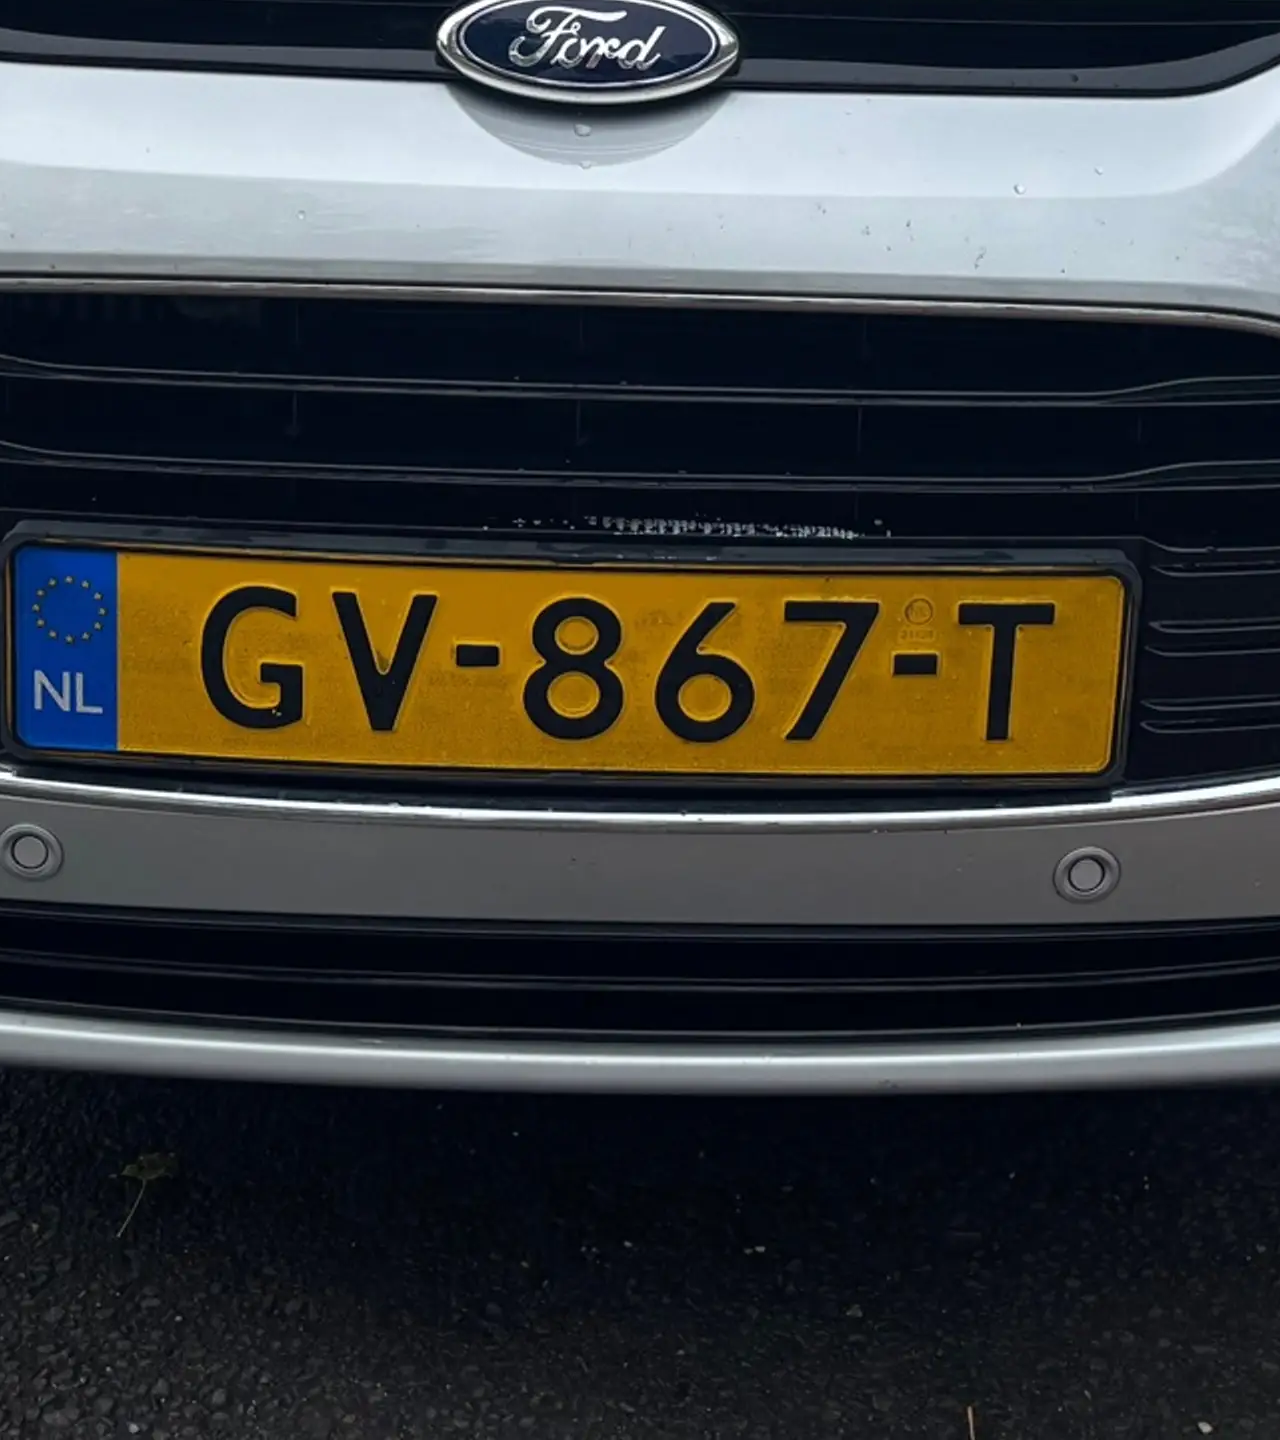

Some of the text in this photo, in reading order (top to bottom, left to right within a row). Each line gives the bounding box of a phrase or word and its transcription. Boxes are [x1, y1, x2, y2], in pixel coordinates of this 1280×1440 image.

[508, 5, 663, 71] Ford
[34, 669, 103, 714] NL
[199, 585, 1056, 742] GV-867-T
